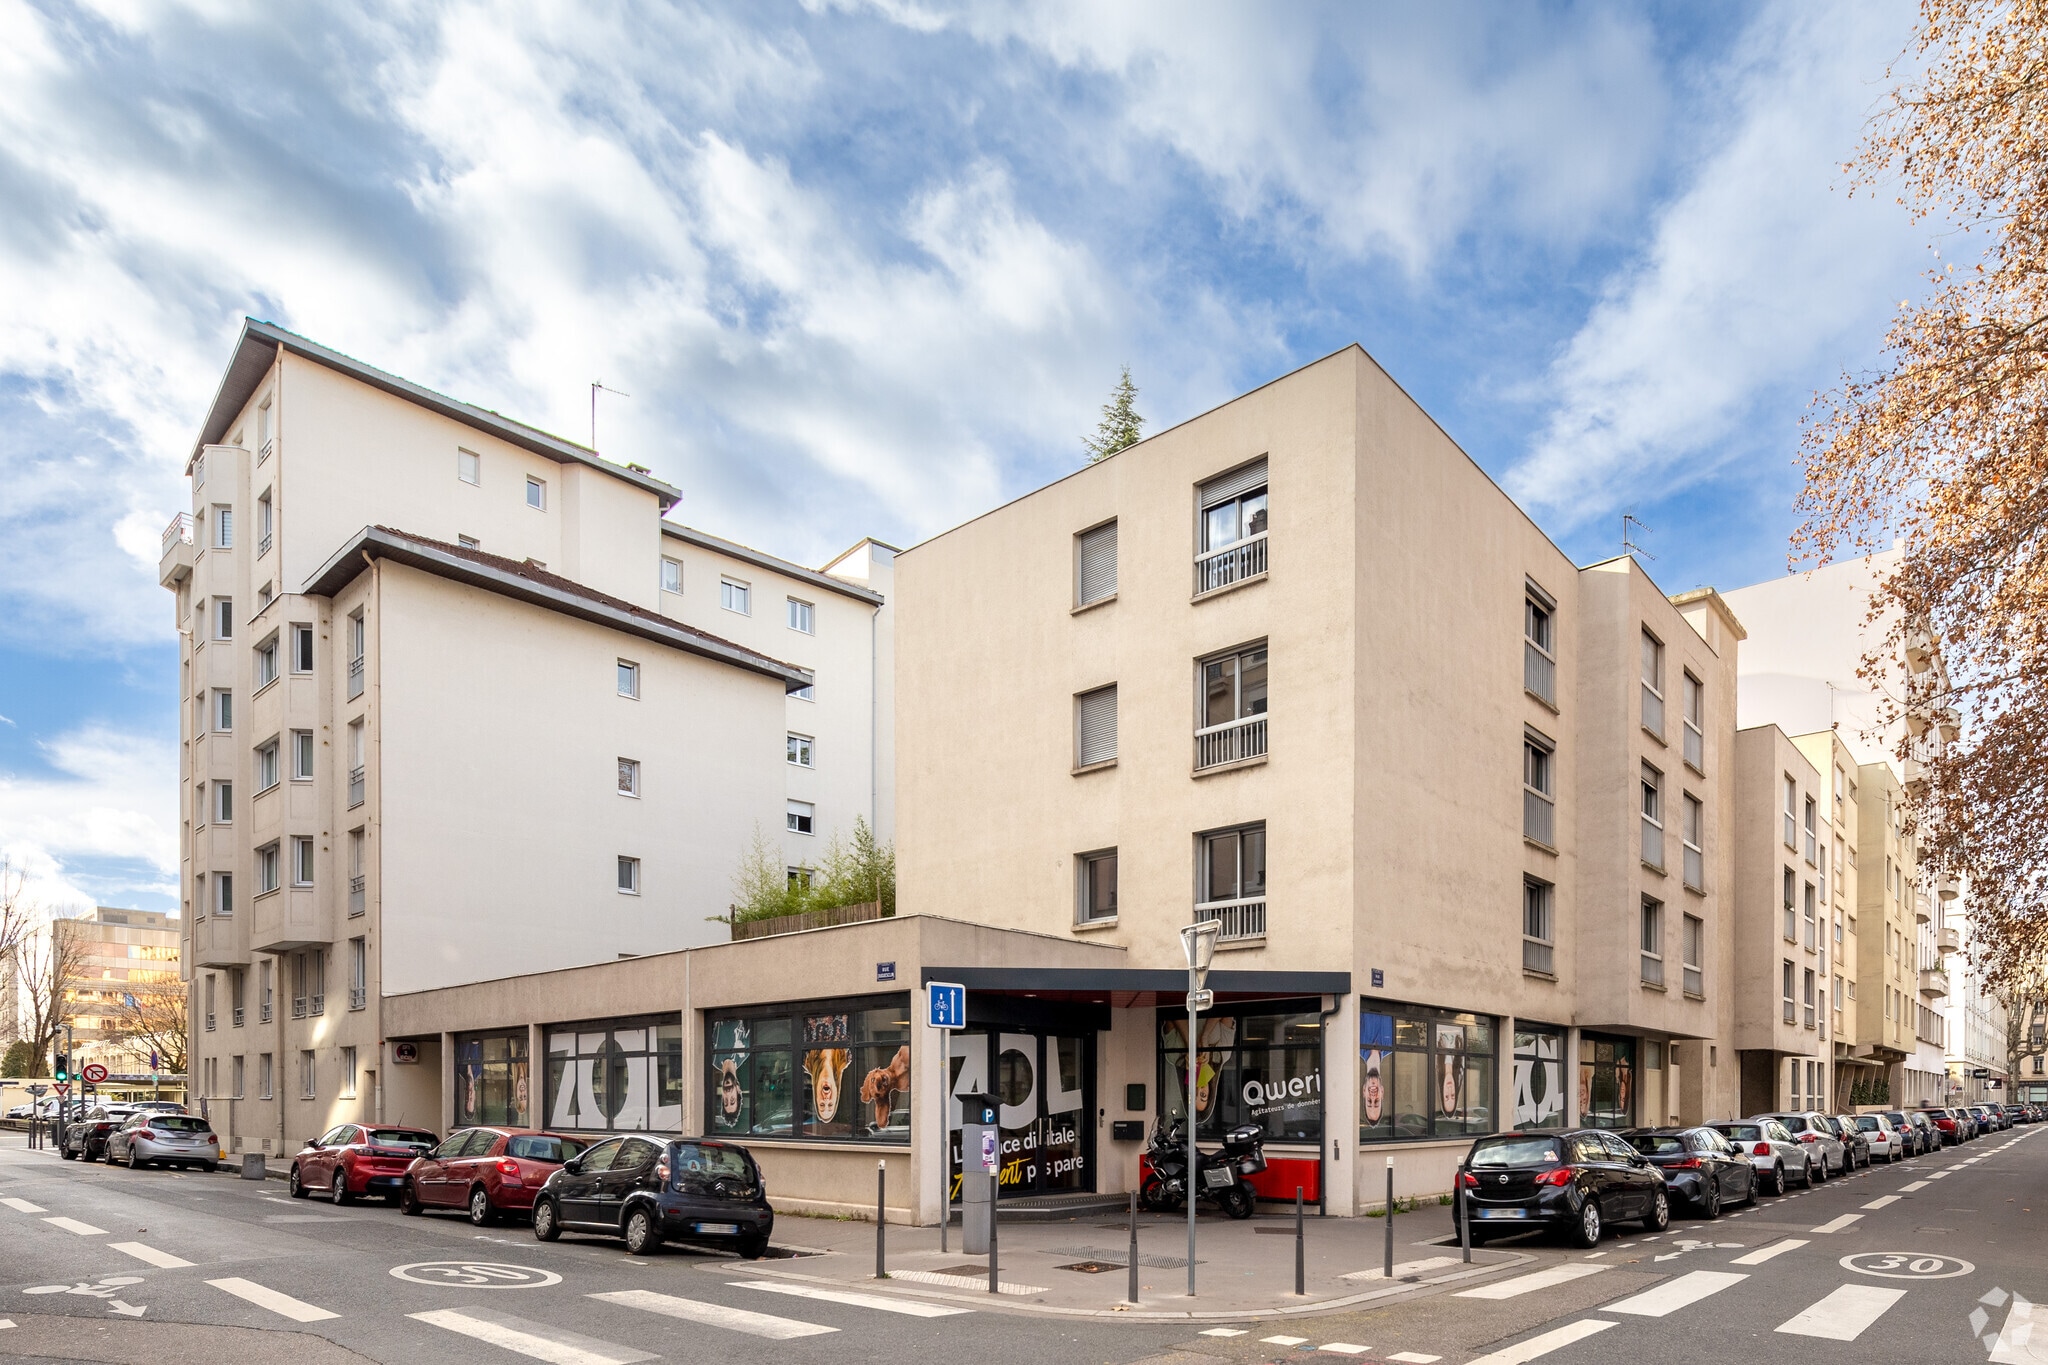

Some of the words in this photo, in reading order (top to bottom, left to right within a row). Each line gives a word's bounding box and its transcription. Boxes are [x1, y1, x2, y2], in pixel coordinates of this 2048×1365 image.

[1242, 1067, 1321, 1106] Qweri
[985, 1108, 993, 1123] P
[1251, 1105, 1285, 1117] Agitateurs
[1287, 1102, 1295, 1110] de
[1026, 1161, 1052, 1183] ps
[1867, 1255, 1944, 1273] 30
[420, 1265, 530, 1284] 30
